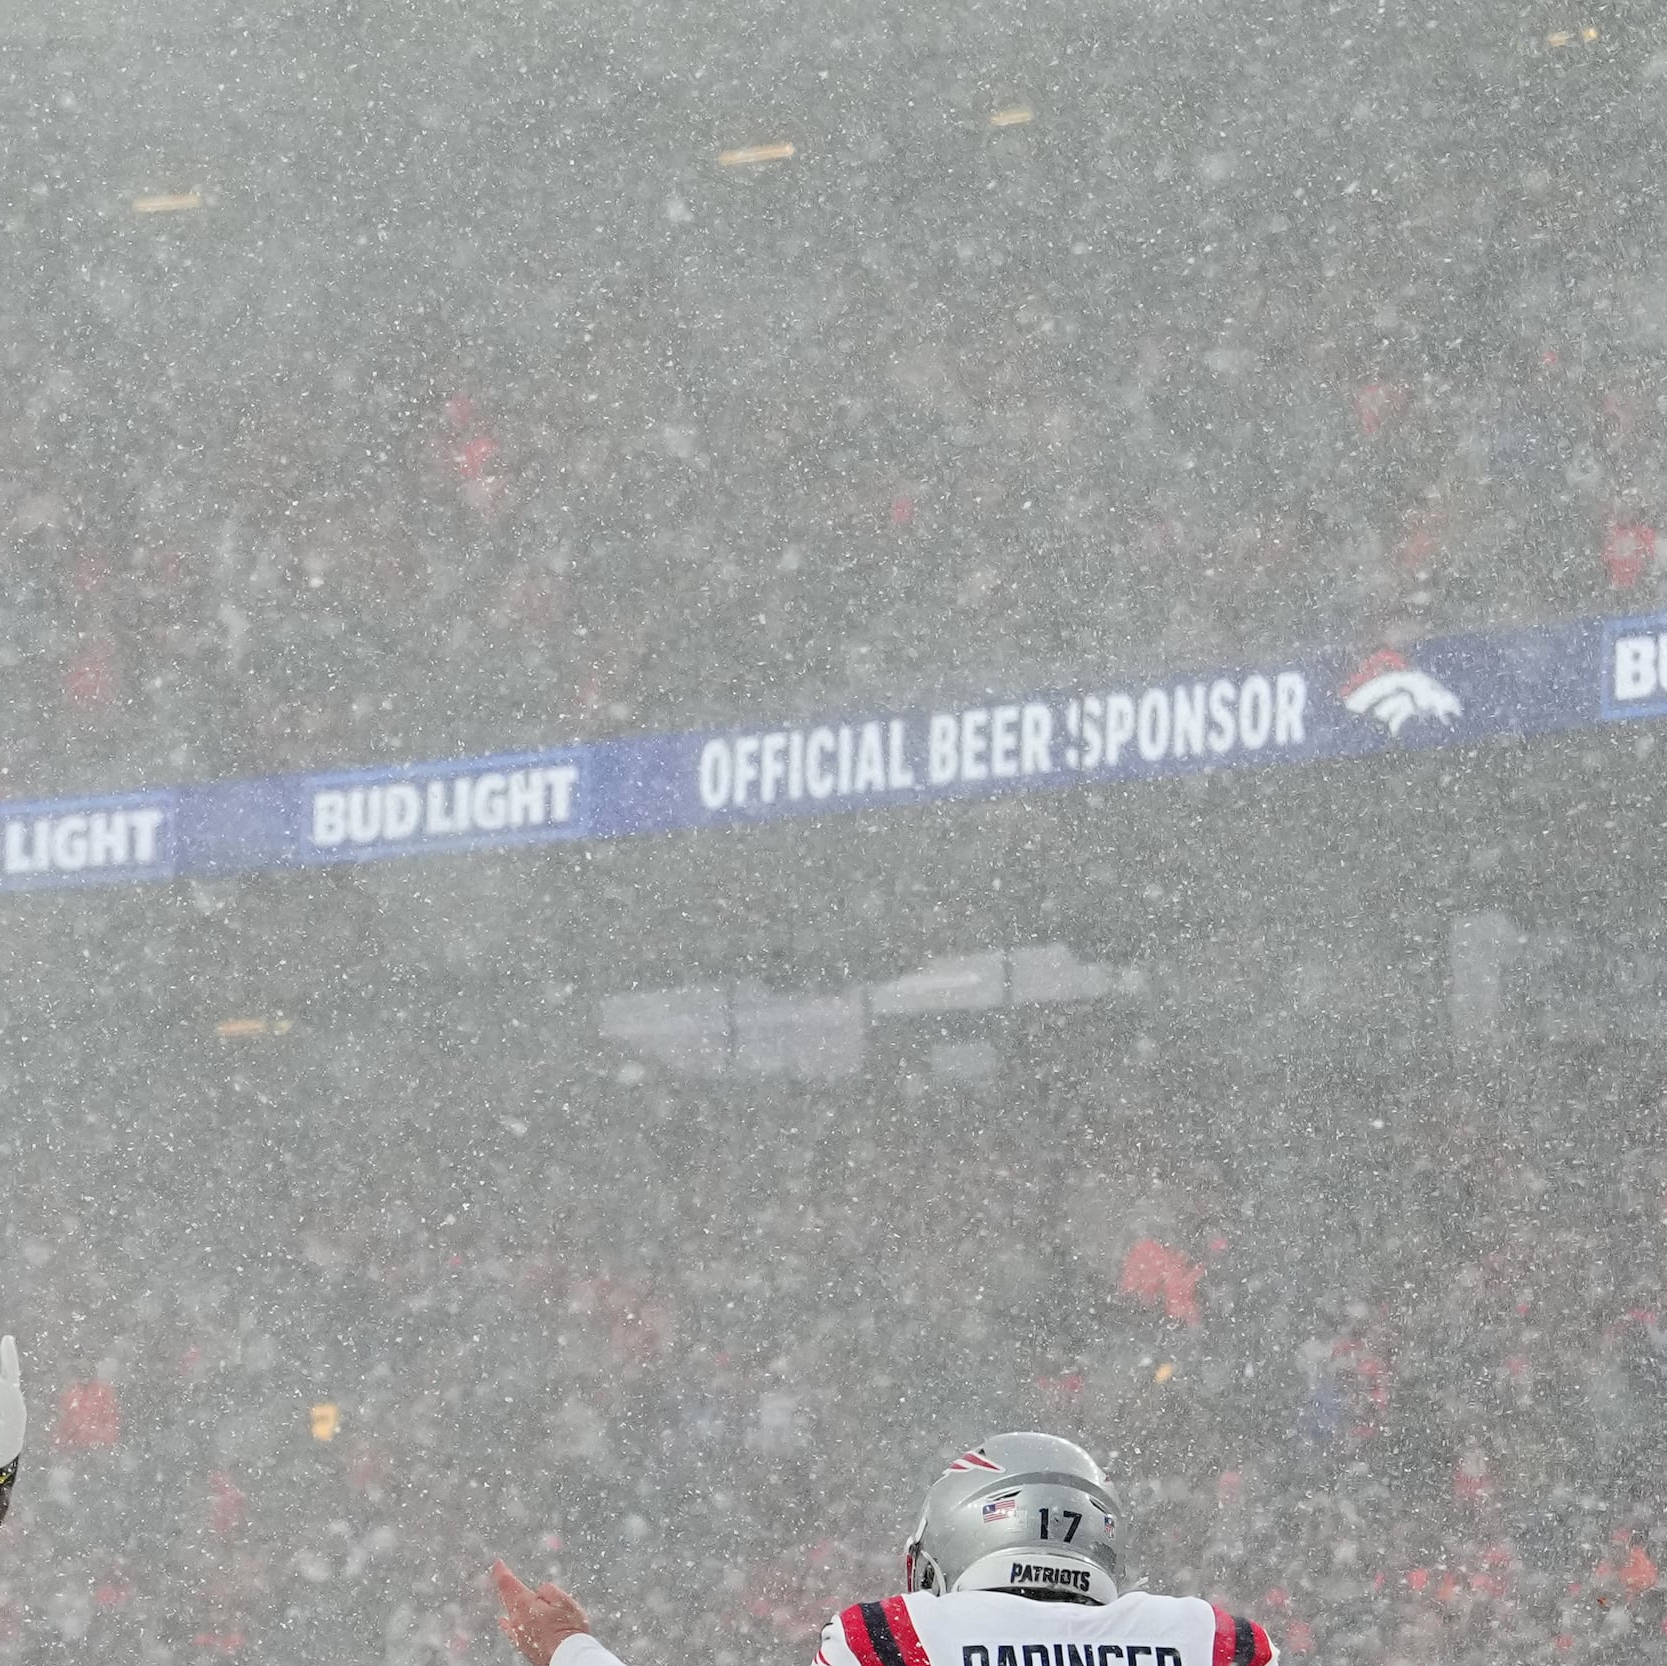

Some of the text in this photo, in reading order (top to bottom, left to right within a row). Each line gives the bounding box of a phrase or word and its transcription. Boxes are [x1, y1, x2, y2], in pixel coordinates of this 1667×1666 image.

[1615, 633, 1667, 700] B
[698, 671, 1307, 809] OFFICIAL BEER SPONSOR
[311, 765, 579, 846] BUD LIGHT
[4, 808, 163, 874] LIGHT
[1038, 1508, 1083, 1544] 17
[1010, 1562, 1091, 1593] PATRIOTS
